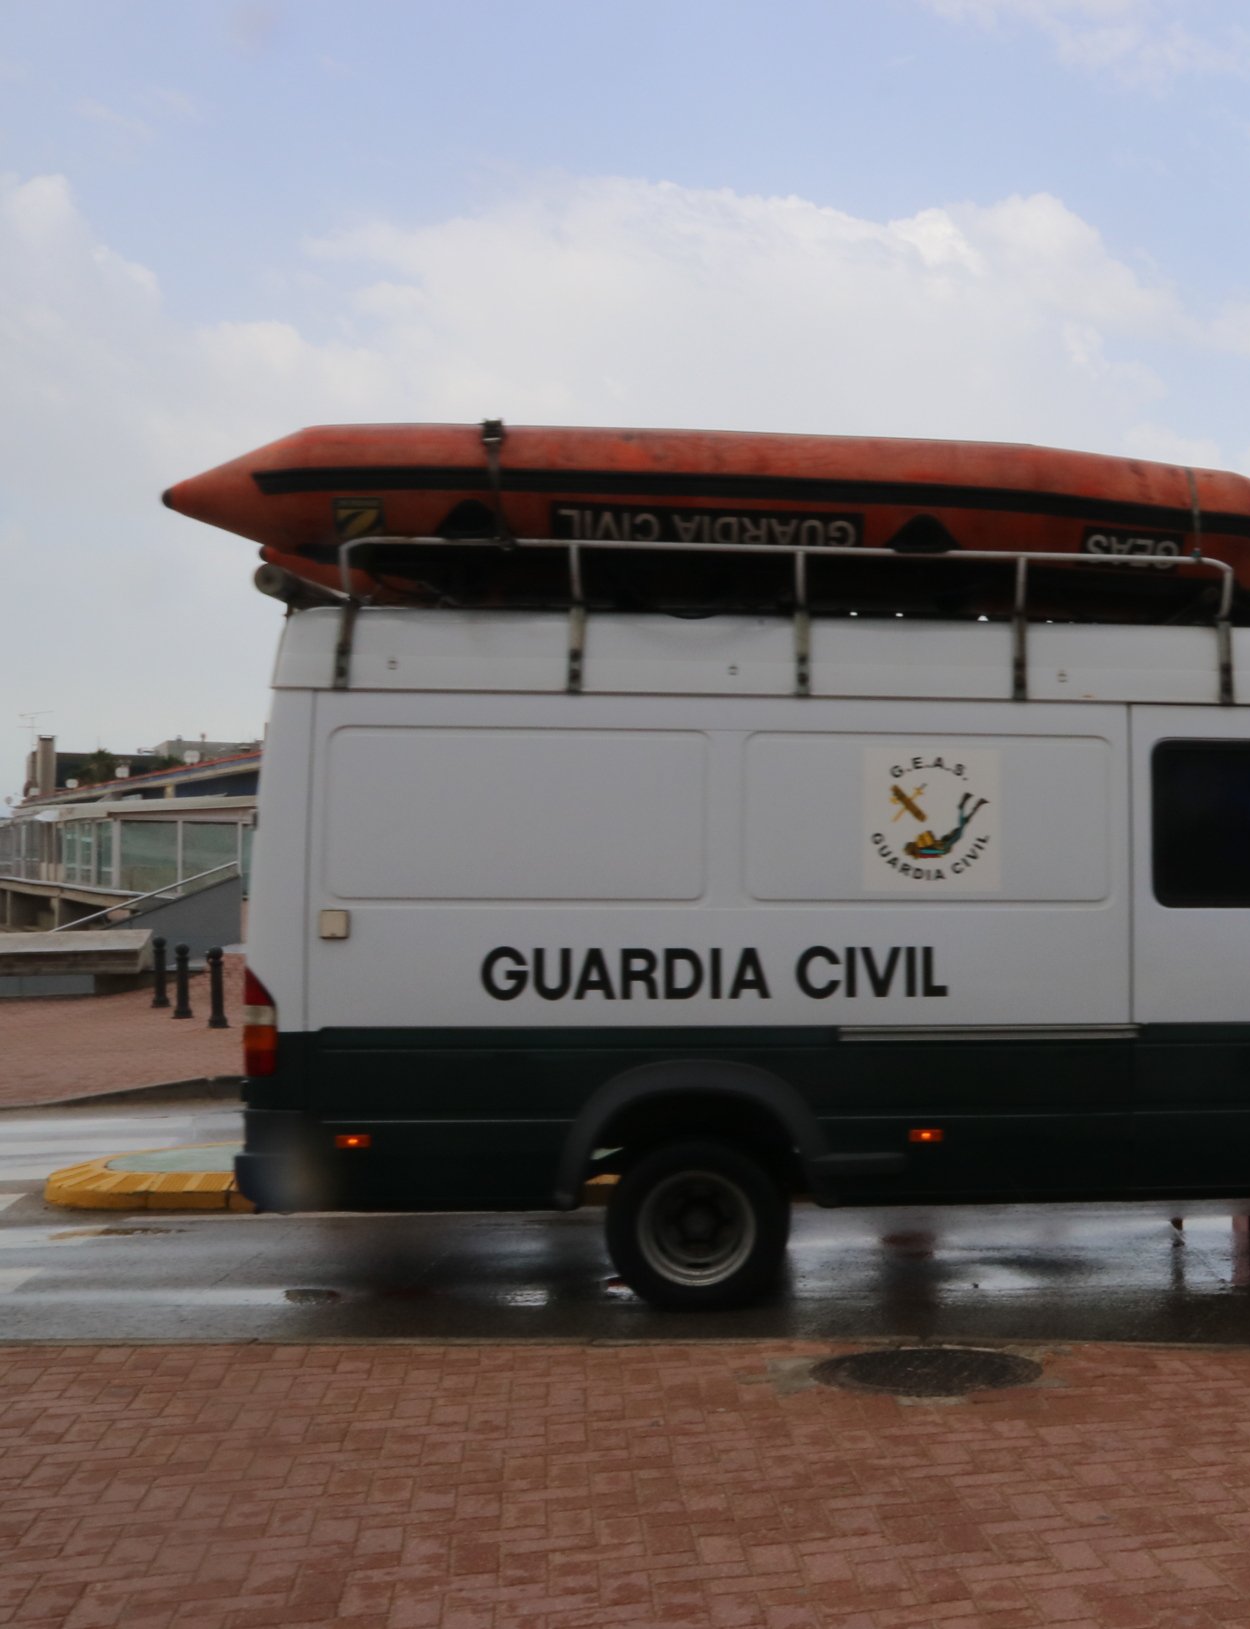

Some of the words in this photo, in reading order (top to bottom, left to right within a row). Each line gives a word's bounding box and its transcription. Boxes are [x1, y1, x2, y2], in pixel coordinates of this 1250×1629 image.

[557, 508, 660, 541] CIVIL
[671, 512, 857, 548] GUARDIA
[871, 832, 946, 881] GUARDIA
[950, 834, 990, 874] CIVIL
[481, 946, 771, 1001] GUARDIA
[795, 945, 949, 1000] CIVIL
